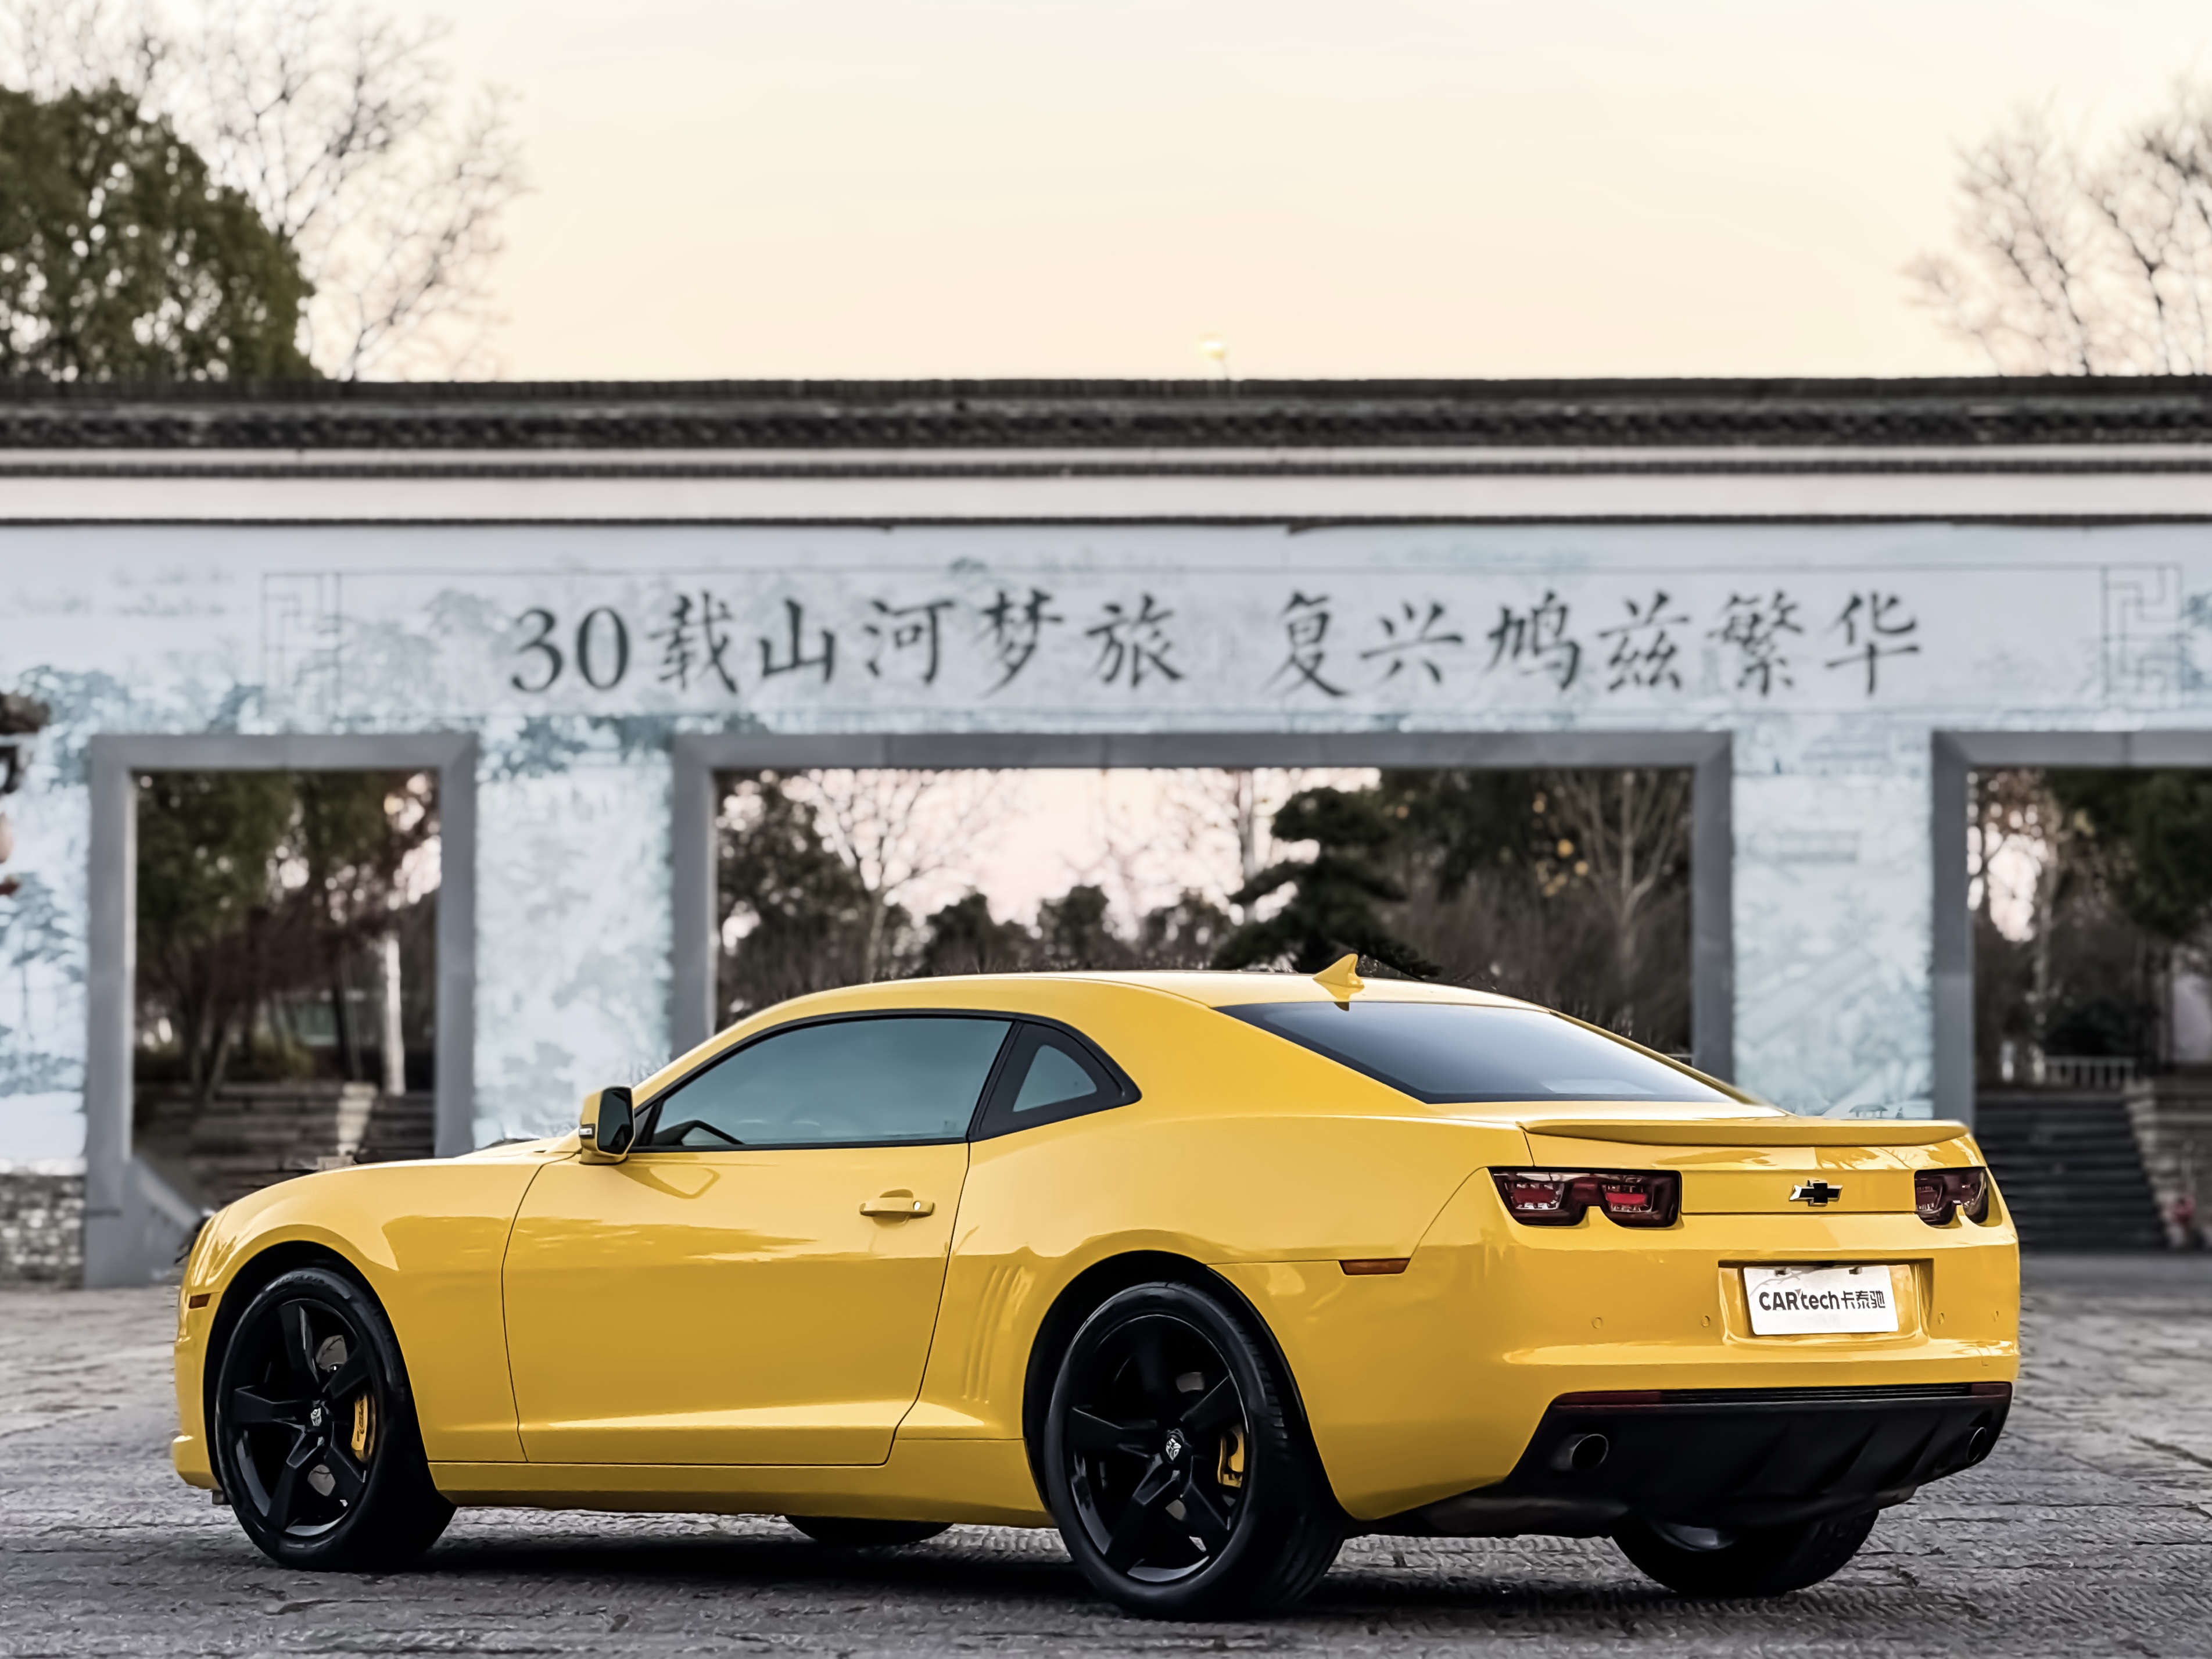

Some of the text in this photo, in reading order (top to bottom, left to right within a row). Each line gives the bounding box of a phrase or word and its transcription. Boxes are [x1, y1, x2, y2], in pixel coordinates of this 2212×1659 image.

[1267, 589, 1921, 697] 复兴鸠兹繁华
